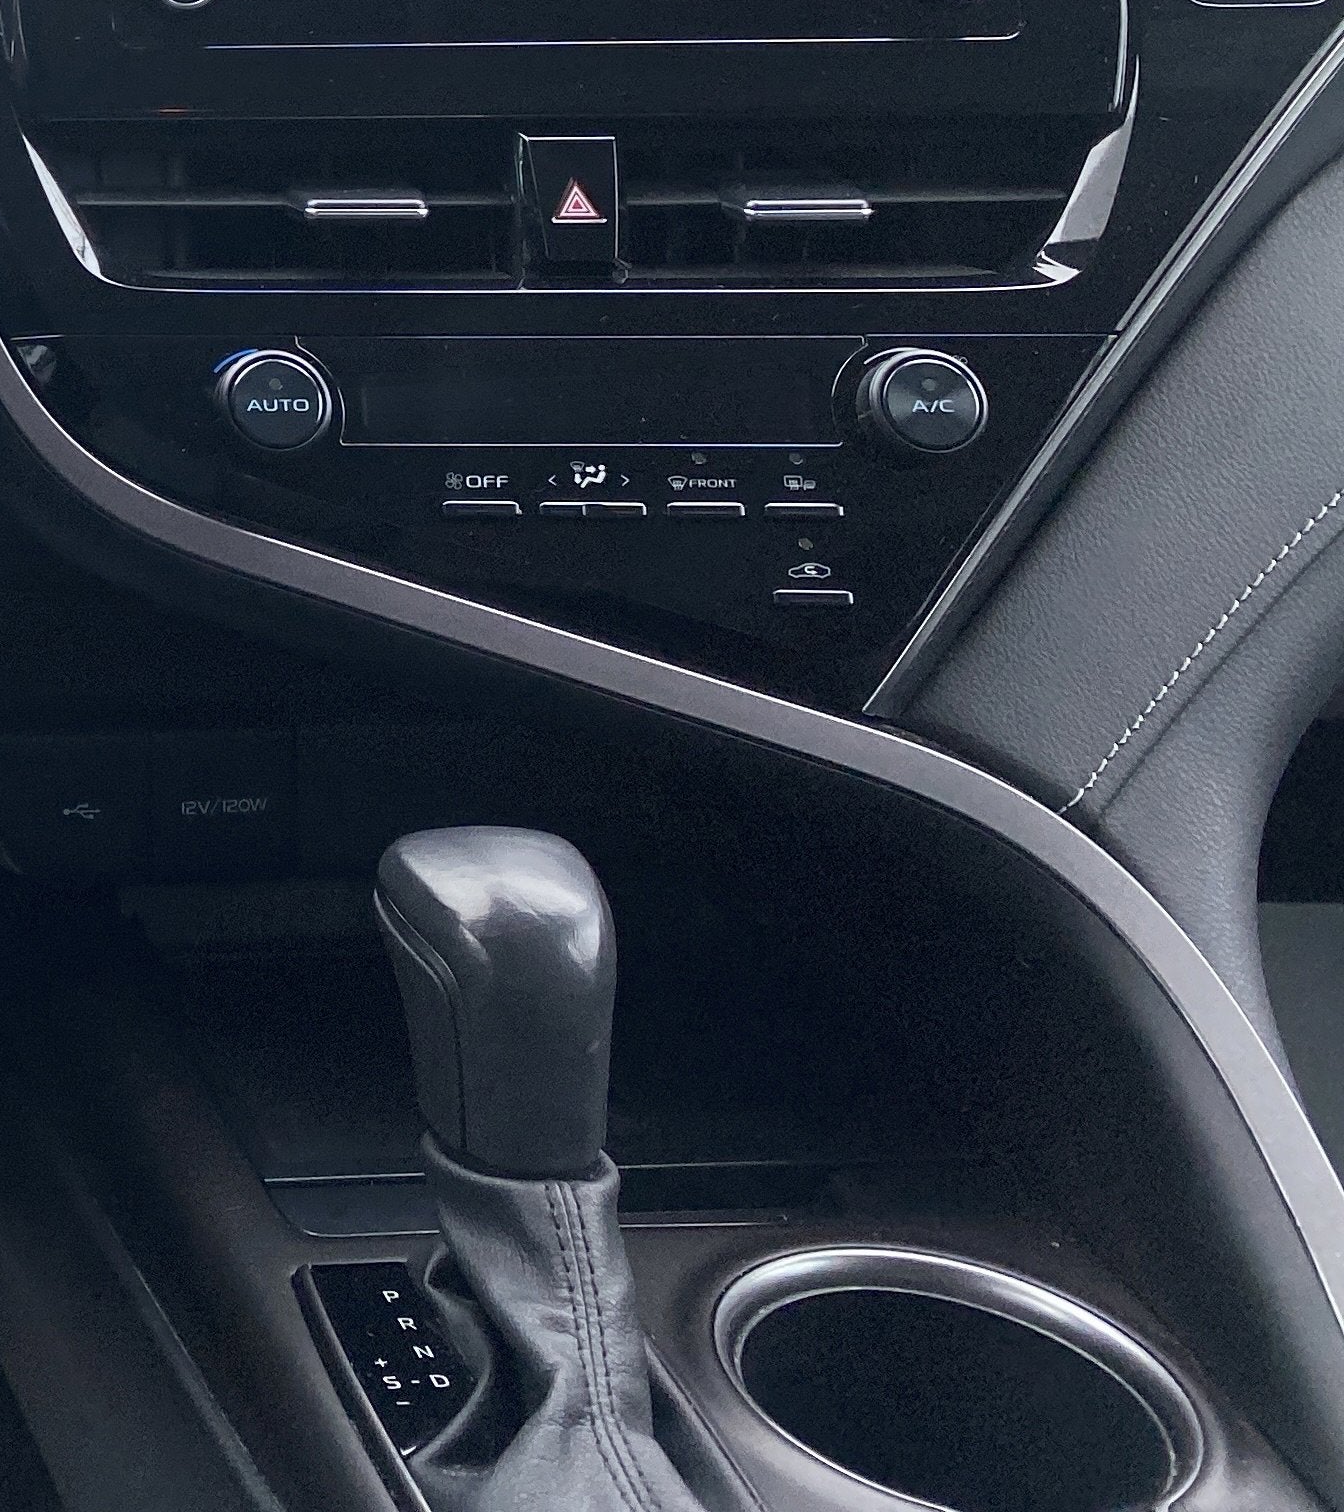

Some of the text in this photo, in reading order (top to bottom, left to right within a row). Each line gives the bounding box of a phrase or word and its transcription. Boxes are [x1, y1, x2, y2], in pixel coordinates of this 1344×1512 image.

[247, 399, 309, 412] AUTO
[912, 399, 955, 413] A/C
[466, 475, 509, 488] OFF
[688, 478, 737, 489] FRONT
[181, 798, 267, 815] 12V/120W
[382, 1290, 399, 1303] P
[397, 1317, 417, 1330] R
[413, 1345, 434, 1358] N
[382, 1374, 450, 1389] S D
